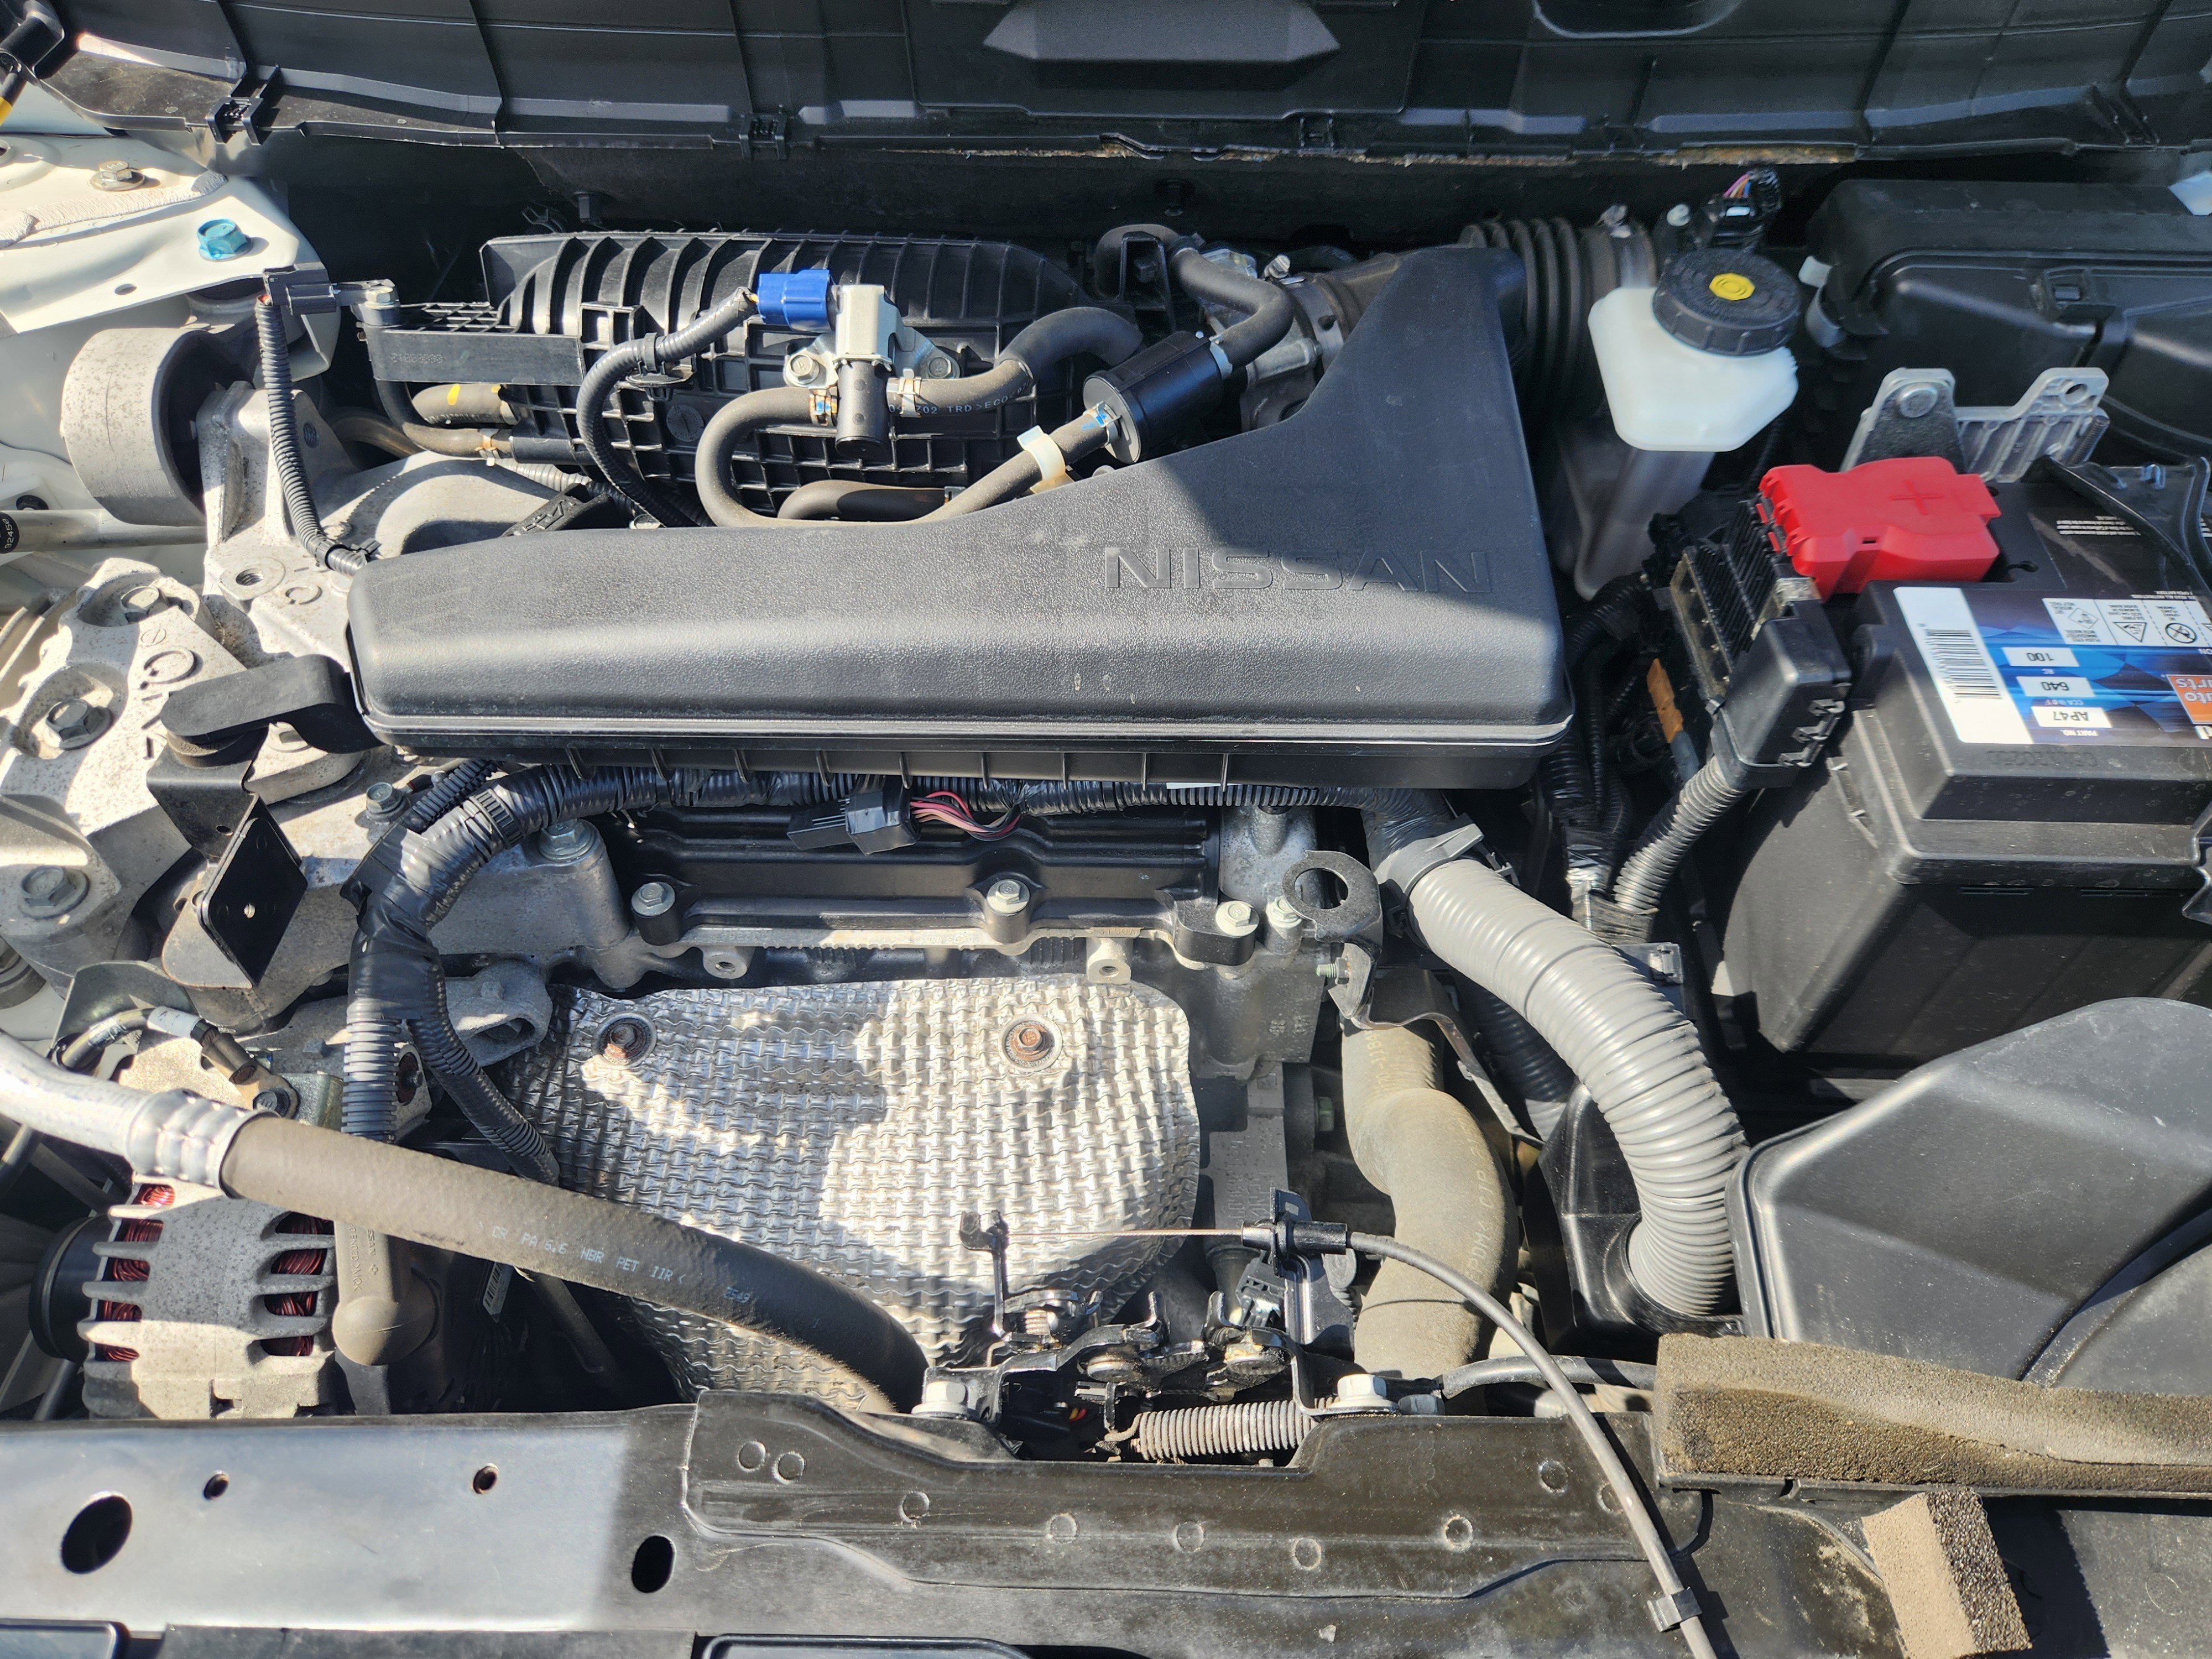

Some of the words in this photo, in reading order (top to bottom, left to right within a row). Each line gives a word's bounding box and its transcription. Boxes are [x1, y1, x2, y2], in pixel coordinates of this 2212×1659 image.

[948, 405, 972, 414] TRD
[2, 518, 14, 549] 92450
[1104, 546, 1491, 593] NISSAN
[2026, 653, 2055, 661] 100
[2041, 681, 2069, 691] 640
[2053, 711, 2090, 721] AP47
[492, 1225, 509, 1240] CR
[520, 1233, 538, 1246] PA
[580, 1247, 605, 1264] NBR
[616, 1256, 639, 1272] PET
